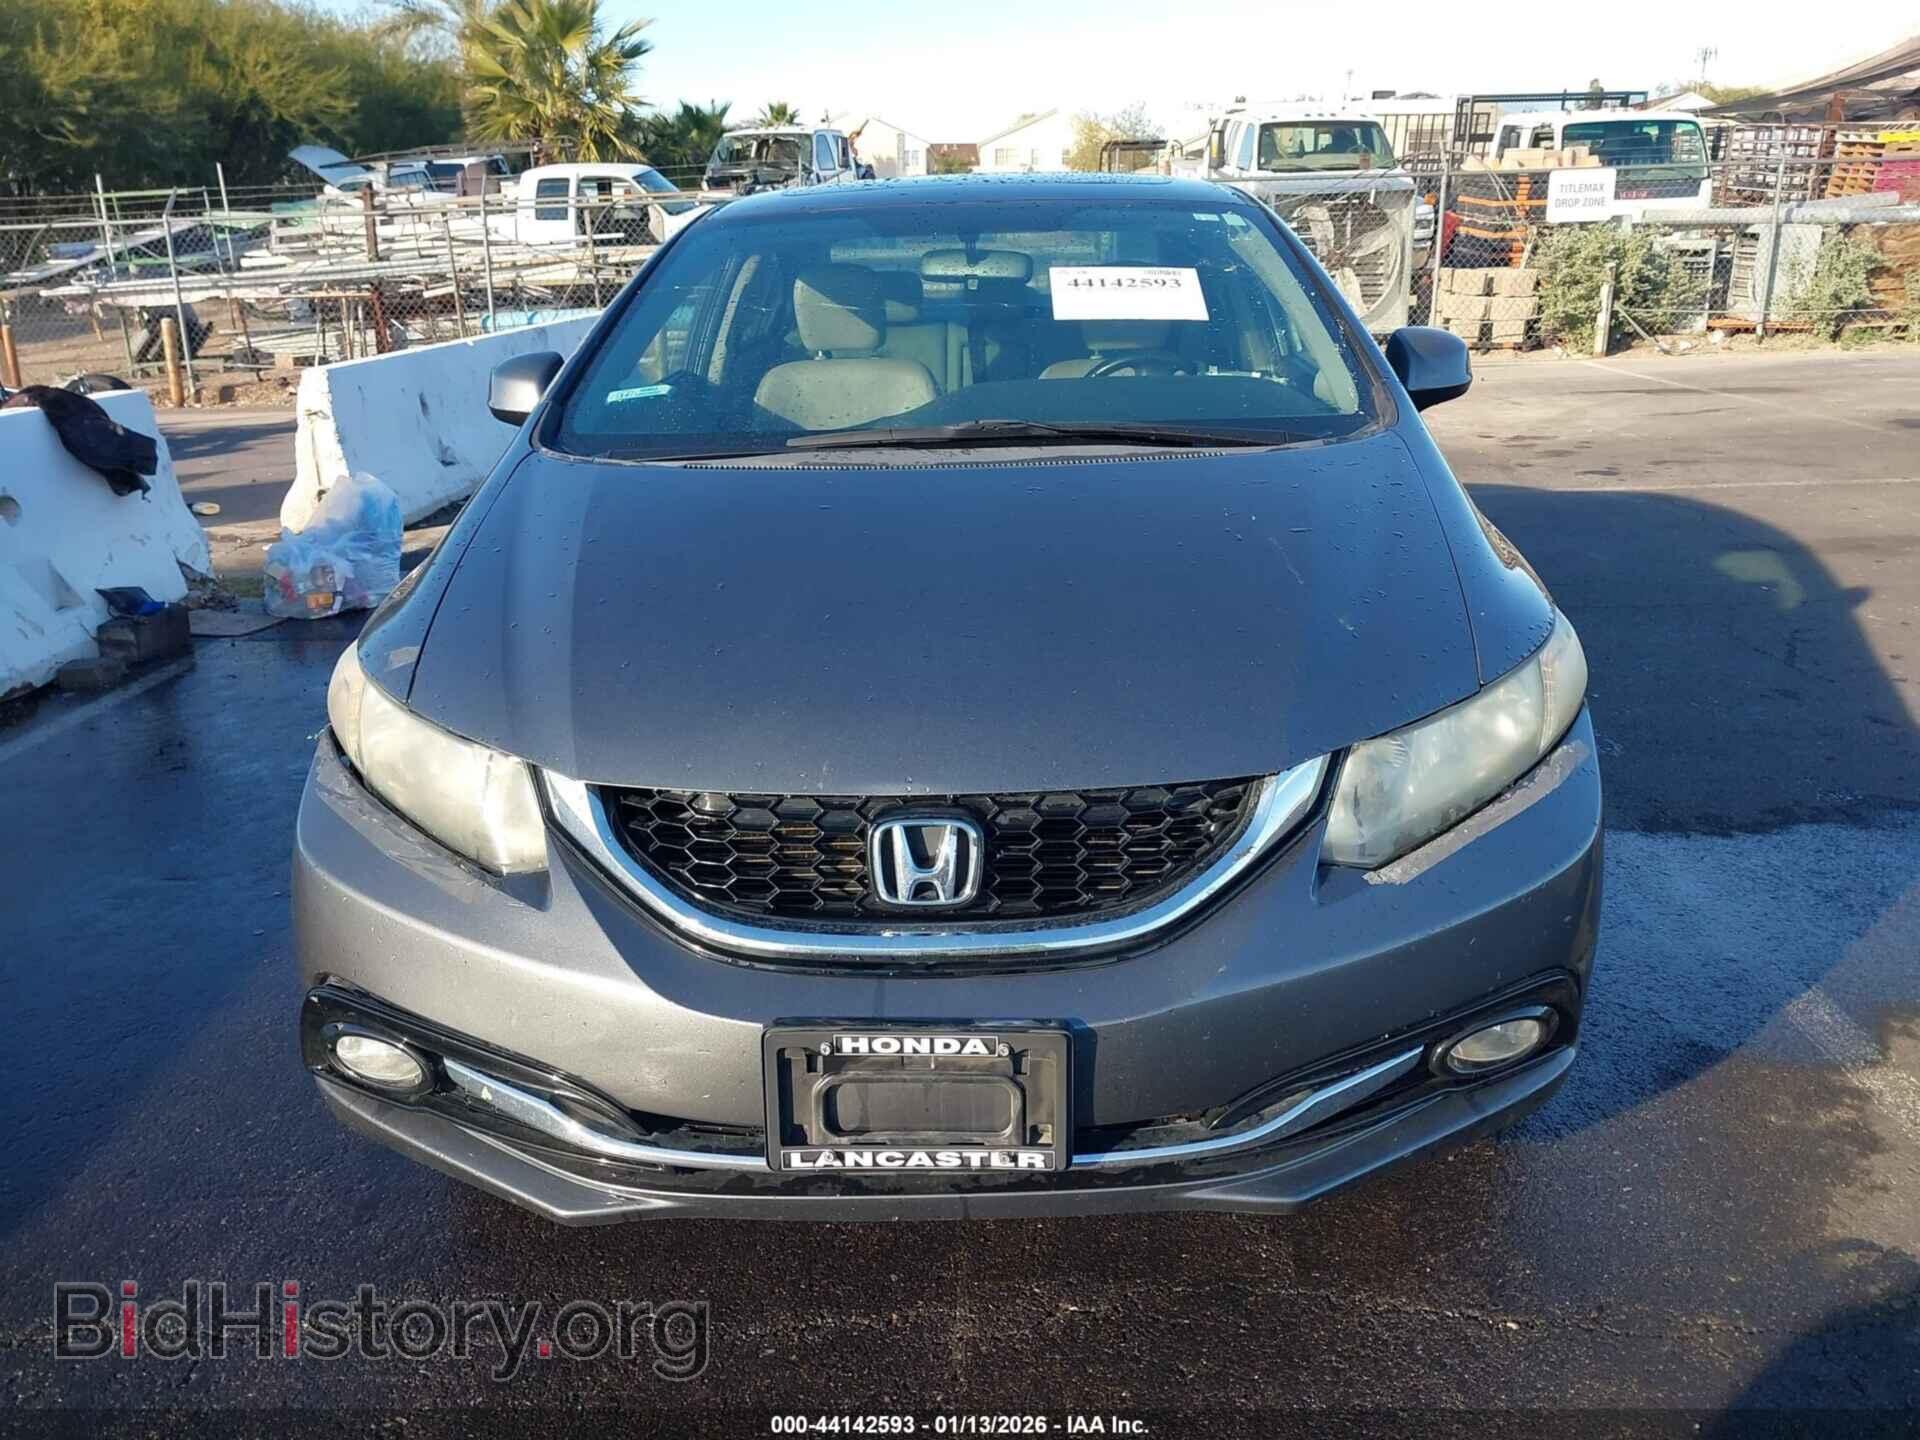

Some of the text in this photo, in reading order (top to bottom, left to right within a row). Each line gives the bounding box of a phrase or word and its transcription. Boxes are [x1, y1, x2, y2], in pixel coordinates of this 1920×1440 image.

[1560, 183, 1605, 193] TITLEMAX
[1554, 197, 1606, 209] DROP ZONE
[1067, 278, 1182, 288] 44142593
[841, 1037, 990, 1054] HONDA
[789, 1151, 1045, 1168] LANCASTER
